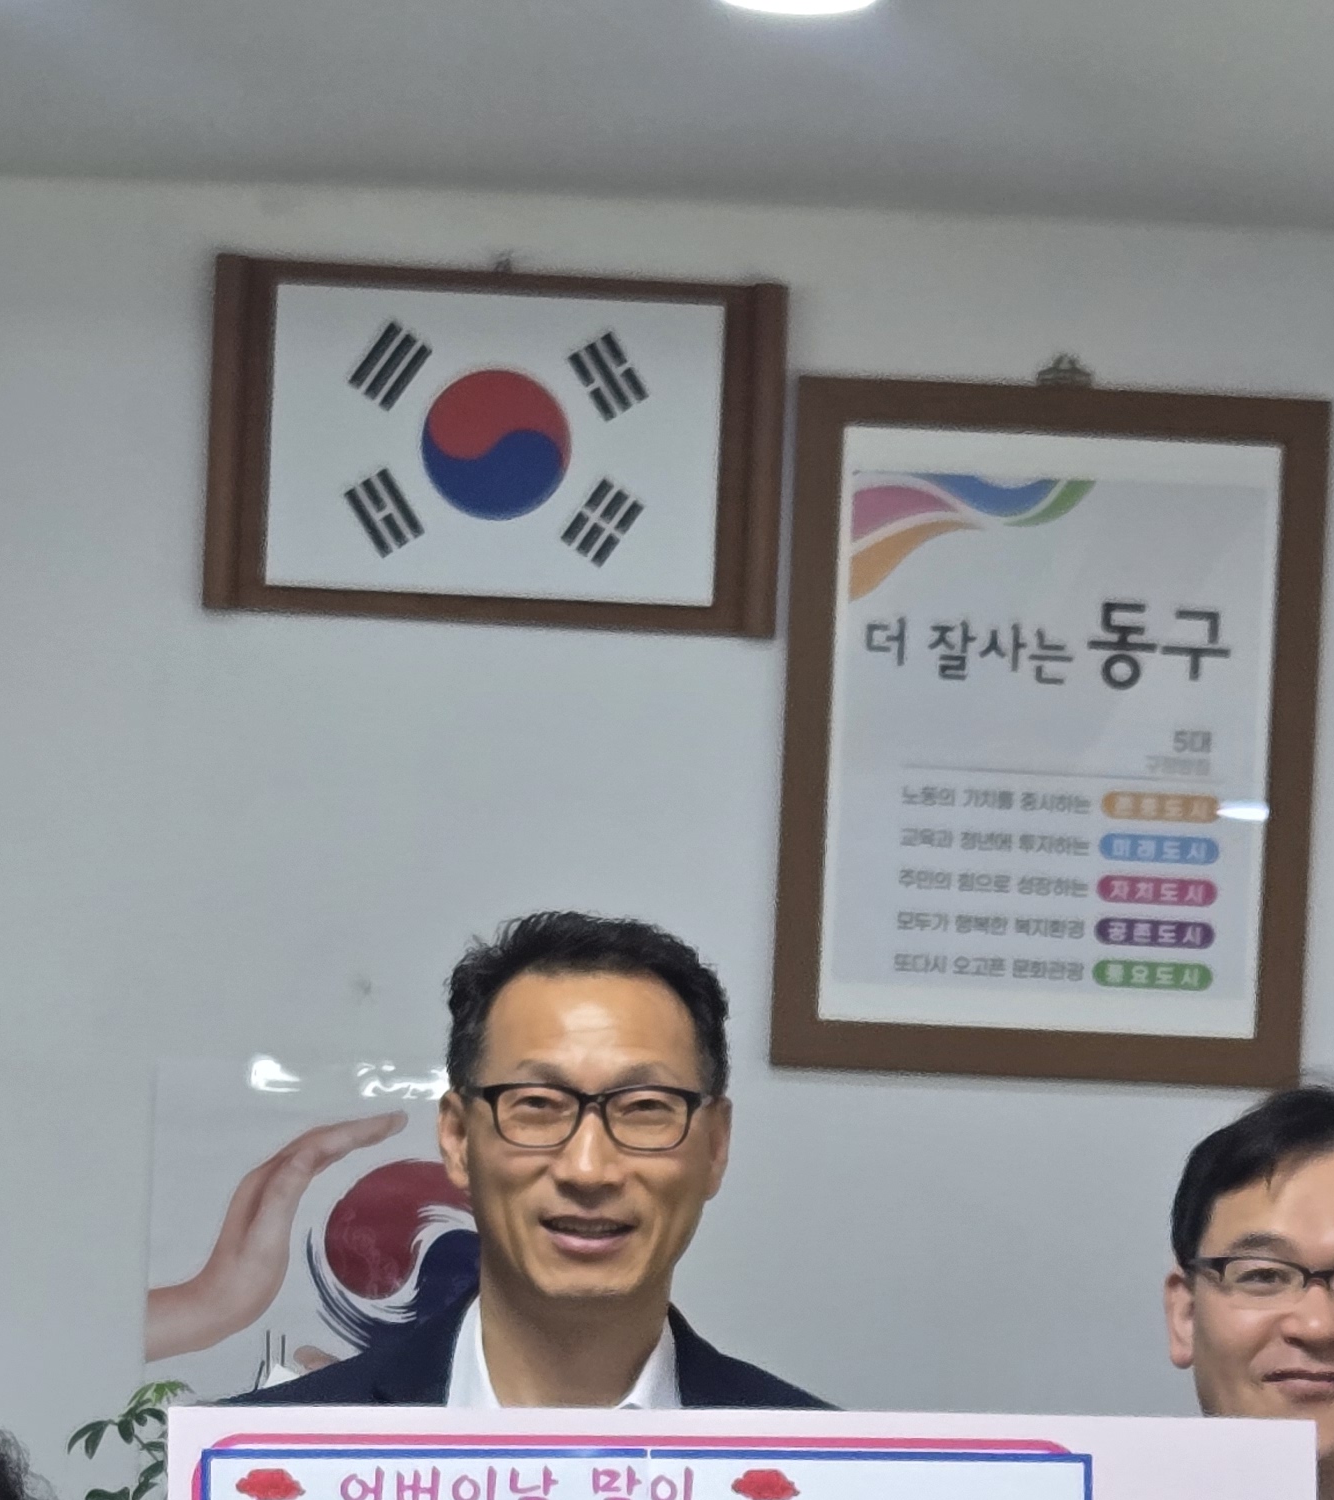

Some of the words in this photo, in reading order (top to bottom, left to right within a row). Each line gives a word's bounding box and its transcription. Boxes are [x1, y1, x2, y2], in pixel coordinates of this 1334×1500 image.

[866, 616, 907, 666] 더
[927, 620, 1073, 685] 잘사는
[1086, 602, 1231, 690] 동구
[1172, 730, 1212, 753] 5대
[1019, 832, 1091, 856] 투자하는
[1112, 837, 1208, 861] 미래도시
[898, 868, 953, 890] 주민의
[957, 872, 1011, 894] 힘으로
[1017, 875, 1088, 898] 성장하는
[1109, 879, 1206, 904] 자치도시
[896, 911, 950, 932] 모두가
[955, 913, 1008, 936] 행복한
[1014, 917, 1085, 940] 복지환경
[1107, 921, 1204, 947] 공존도시
[893, 953, 947, 974] 또다시
[953, 956, 1006, 978] 오고픈
[1012, 958, 1084, 982] 문화관광
